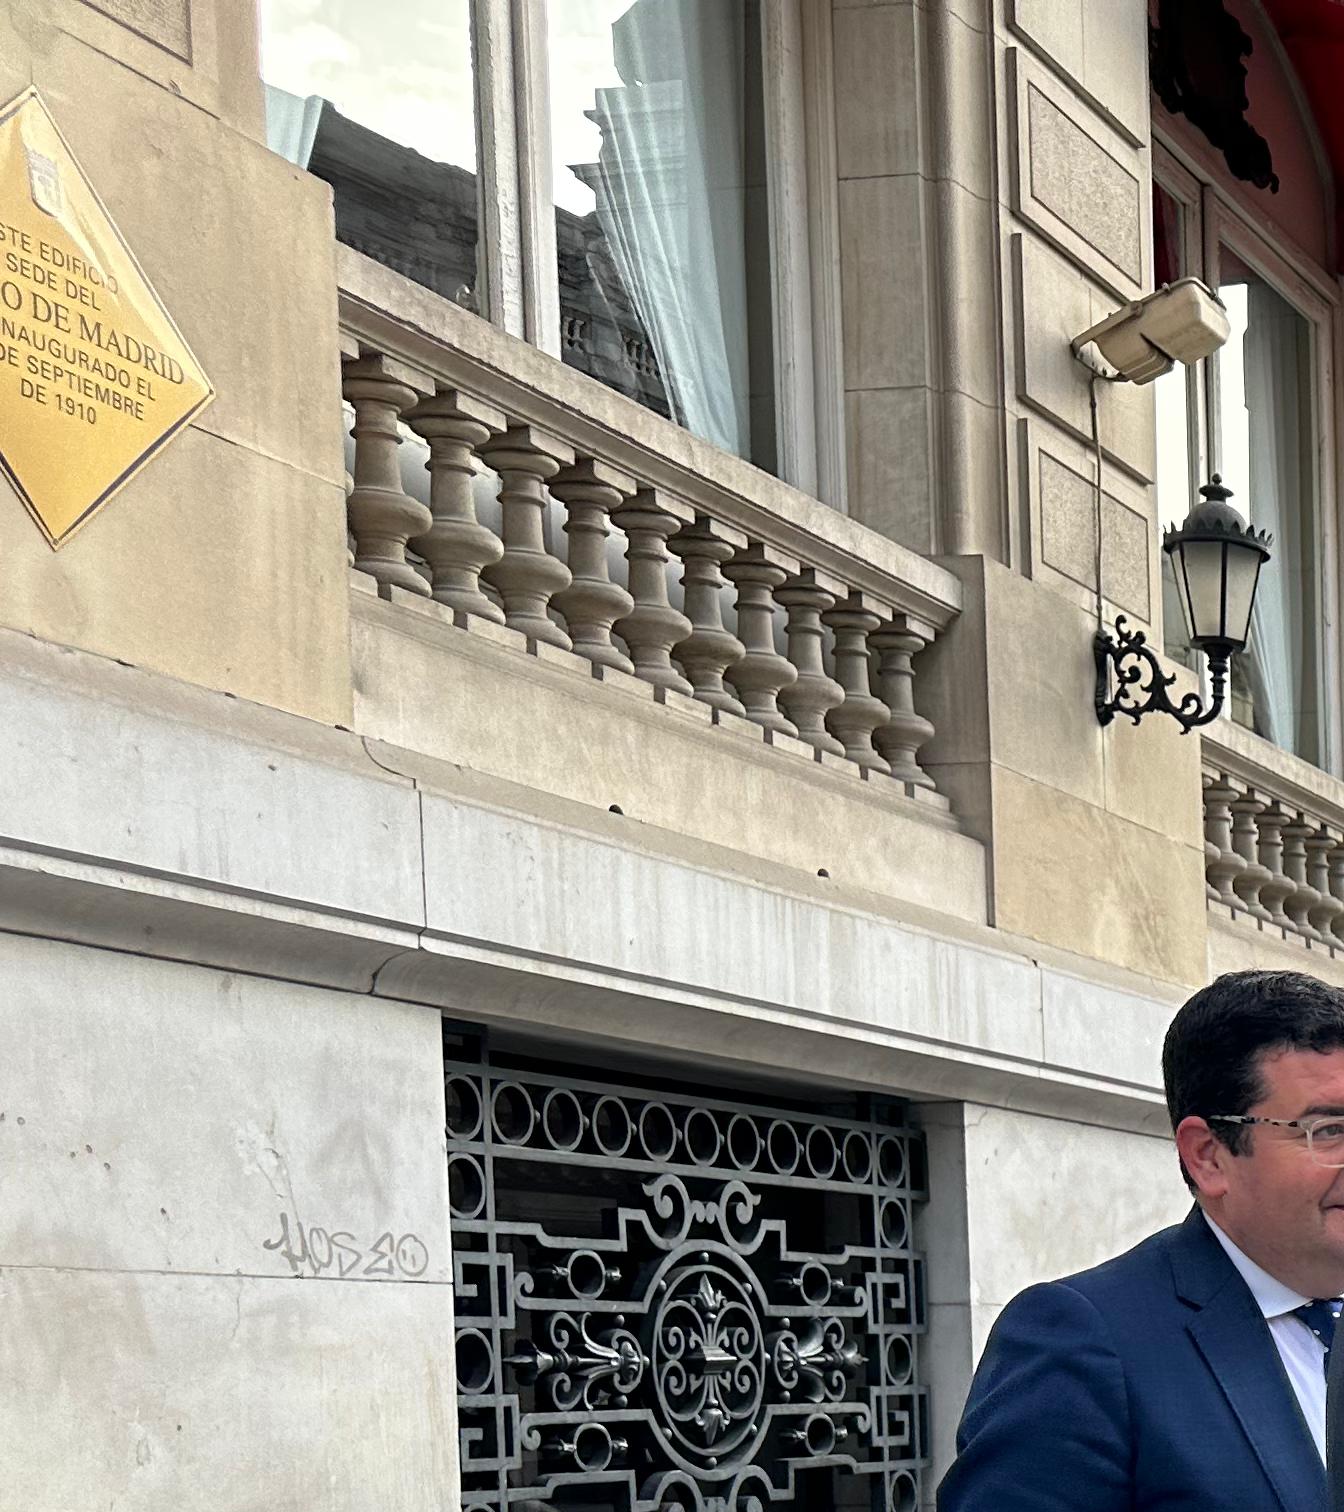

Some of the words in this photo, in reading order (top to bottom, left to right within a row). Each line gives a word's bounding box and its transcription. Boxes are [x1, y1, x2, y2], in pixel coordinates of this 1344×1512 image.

[6, 252, 58, 292] SEDE
[65, 278, 101, 311] DEL
[40, 241, 119, 295] EDIFICIO
[31, 292, 71, 333] DE
[78, 313, 184, 385] MADRID
[20, 378, 47, 405] DE
[56, 393, 97, 425] 1910
[27, 354, 145, 421] SEPTIEMBRE
[137, 376, 156, 402] EL
